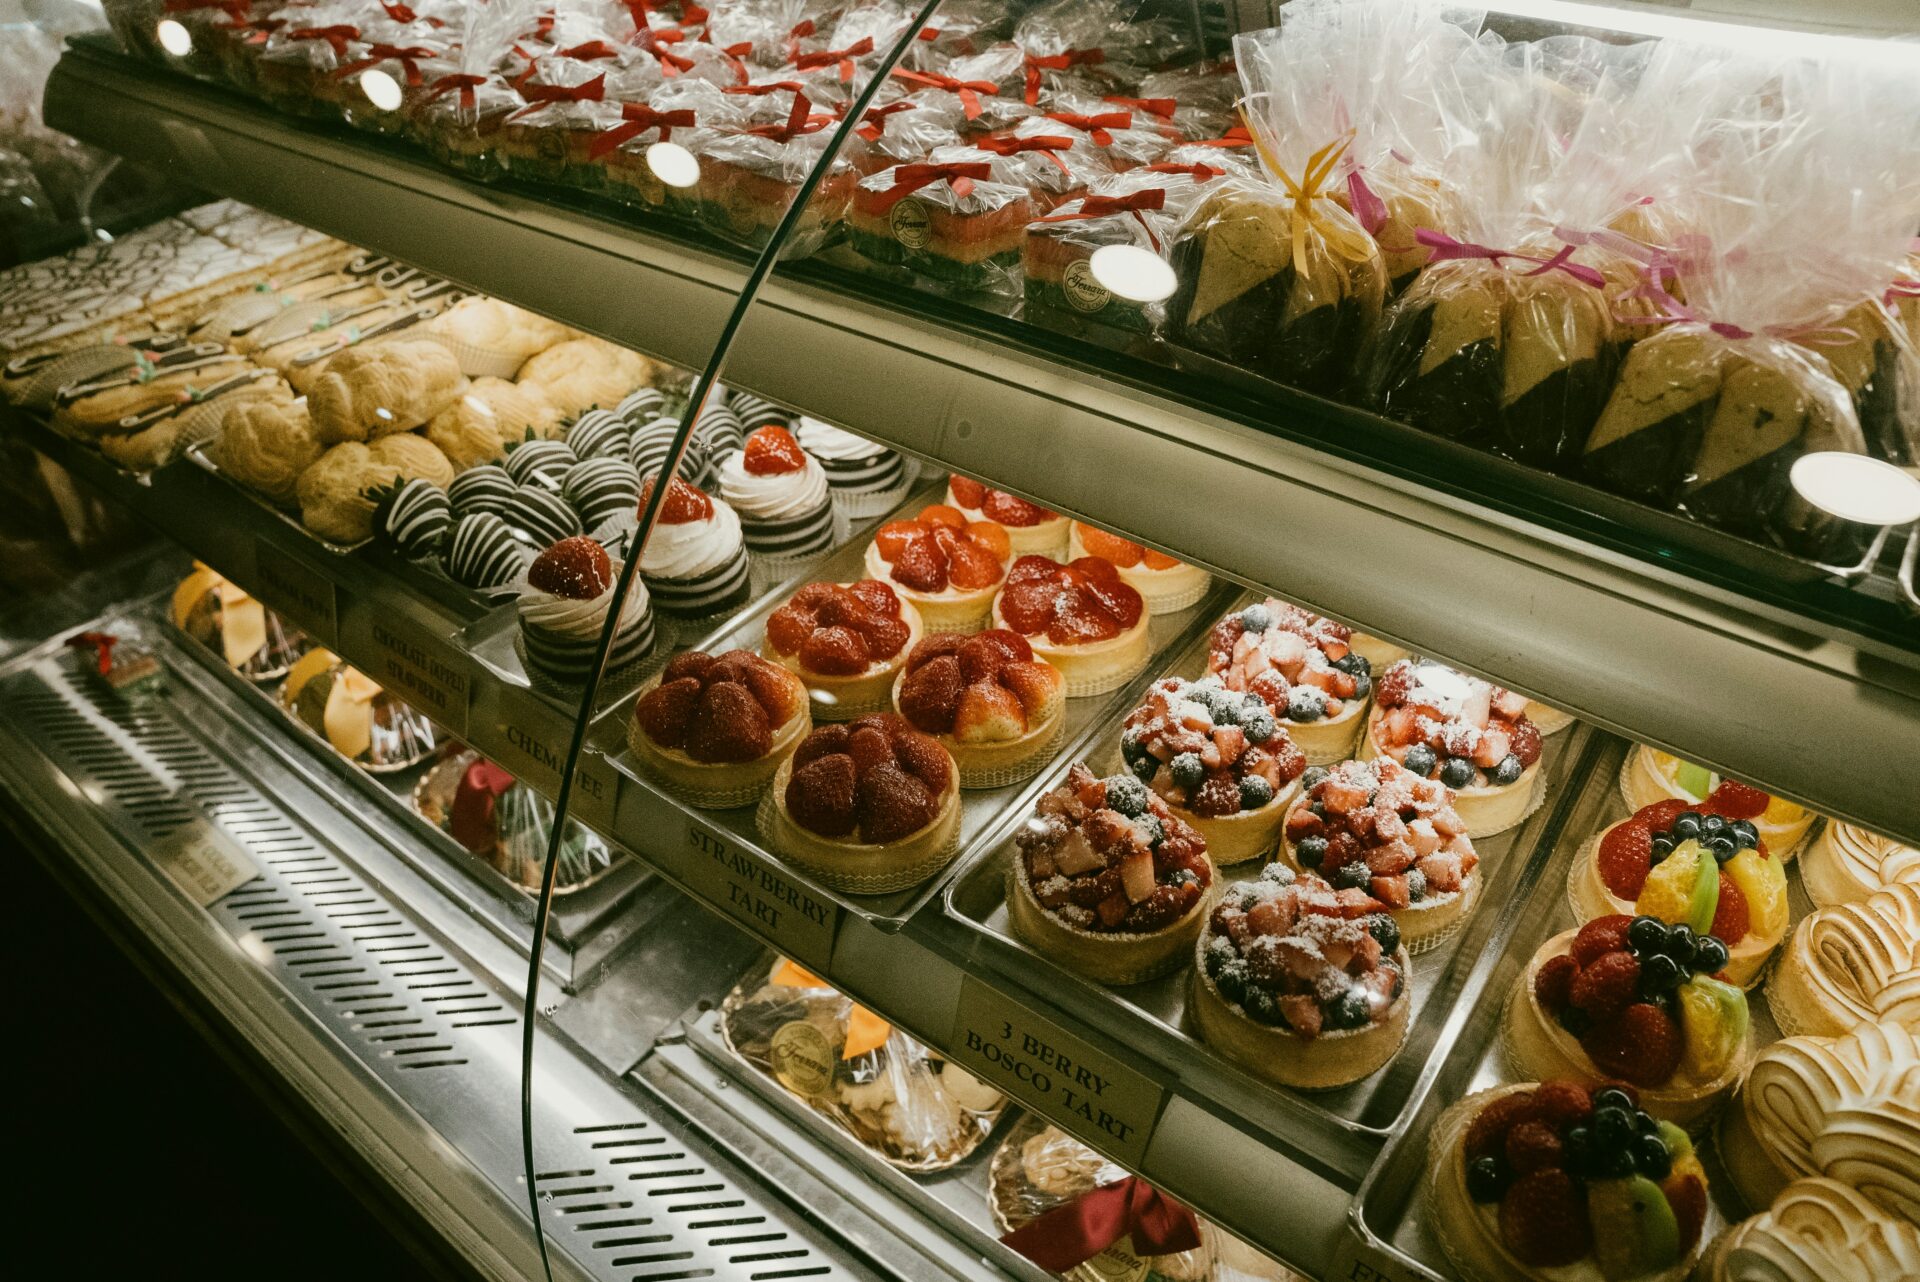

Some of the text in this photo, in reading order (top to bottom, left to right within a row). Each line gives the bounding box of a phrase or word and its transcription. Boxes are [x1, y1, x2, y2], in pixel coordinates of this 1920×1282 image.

[1066, 272, 1108, 296] Ferrara
[689, 827, 830, 928] STRAWBERRY
[727, 880, 783, 929] TART
[965, 1028, 1134, 1144] BOSCO TART
[1000, 1021, 1112, 1097] 3 BERRY
